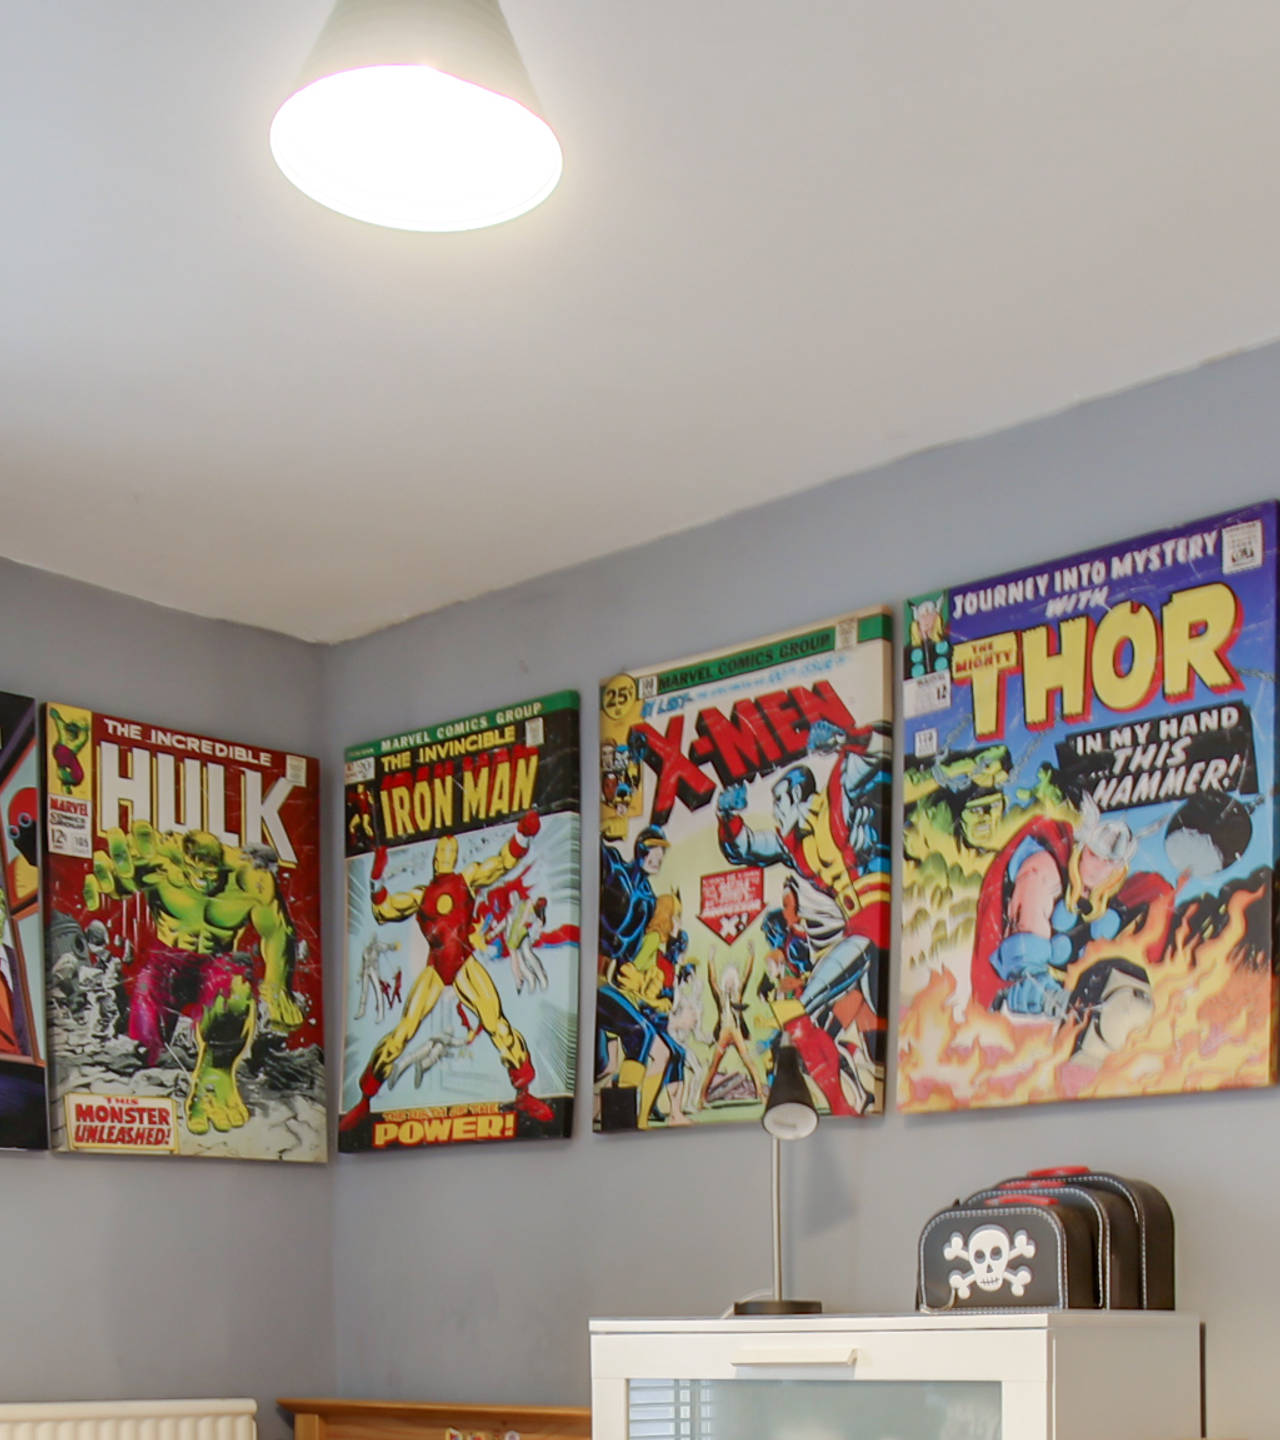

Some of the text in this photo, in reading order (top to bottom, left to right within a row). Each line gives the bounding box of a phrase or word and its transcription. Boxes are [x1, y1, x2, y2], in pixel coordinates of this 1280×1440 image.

[953, 573, 1050, 619] JOURNEY
[1054, 555, 1107, 597] INTO
[1111, 529, 1220, 580] MYSTERY
[1045, 586, 1109, 618] WITH
[660, 666, 712, 690] MARVEL
[718, 651, 774, 675] COMICS
[779, 634, 831, 660] GROUP
[952, 582, 1246, 741] THOR
[955, 651, 1010, 673] MIGHTY
[972, 643, 993, 654] THE
[104, 718, 273, 768] THE INCREDIBLE
[380, 702, 543, 752] MARVEL COMICS GROUP
[380, 752, 412, 773] THE
[419, 725, 517, 764] INVINCIBLE
[629, 680, 856, 823] X-MEN
[1075, 706, 1240, 756] IN MY HAND
[97, 741, 306, 868] HULK
[379, 770, 455, 840] IRON
[461, 751, 540, 823] MAN
[1093, 754, 1241, 809] HAMMER!
[74, 1103, 170, 1127] MONSTER
[74, 1125, 172, 1146] UNLEASHED!
[374, 1112, 517, 1147] POWER!
